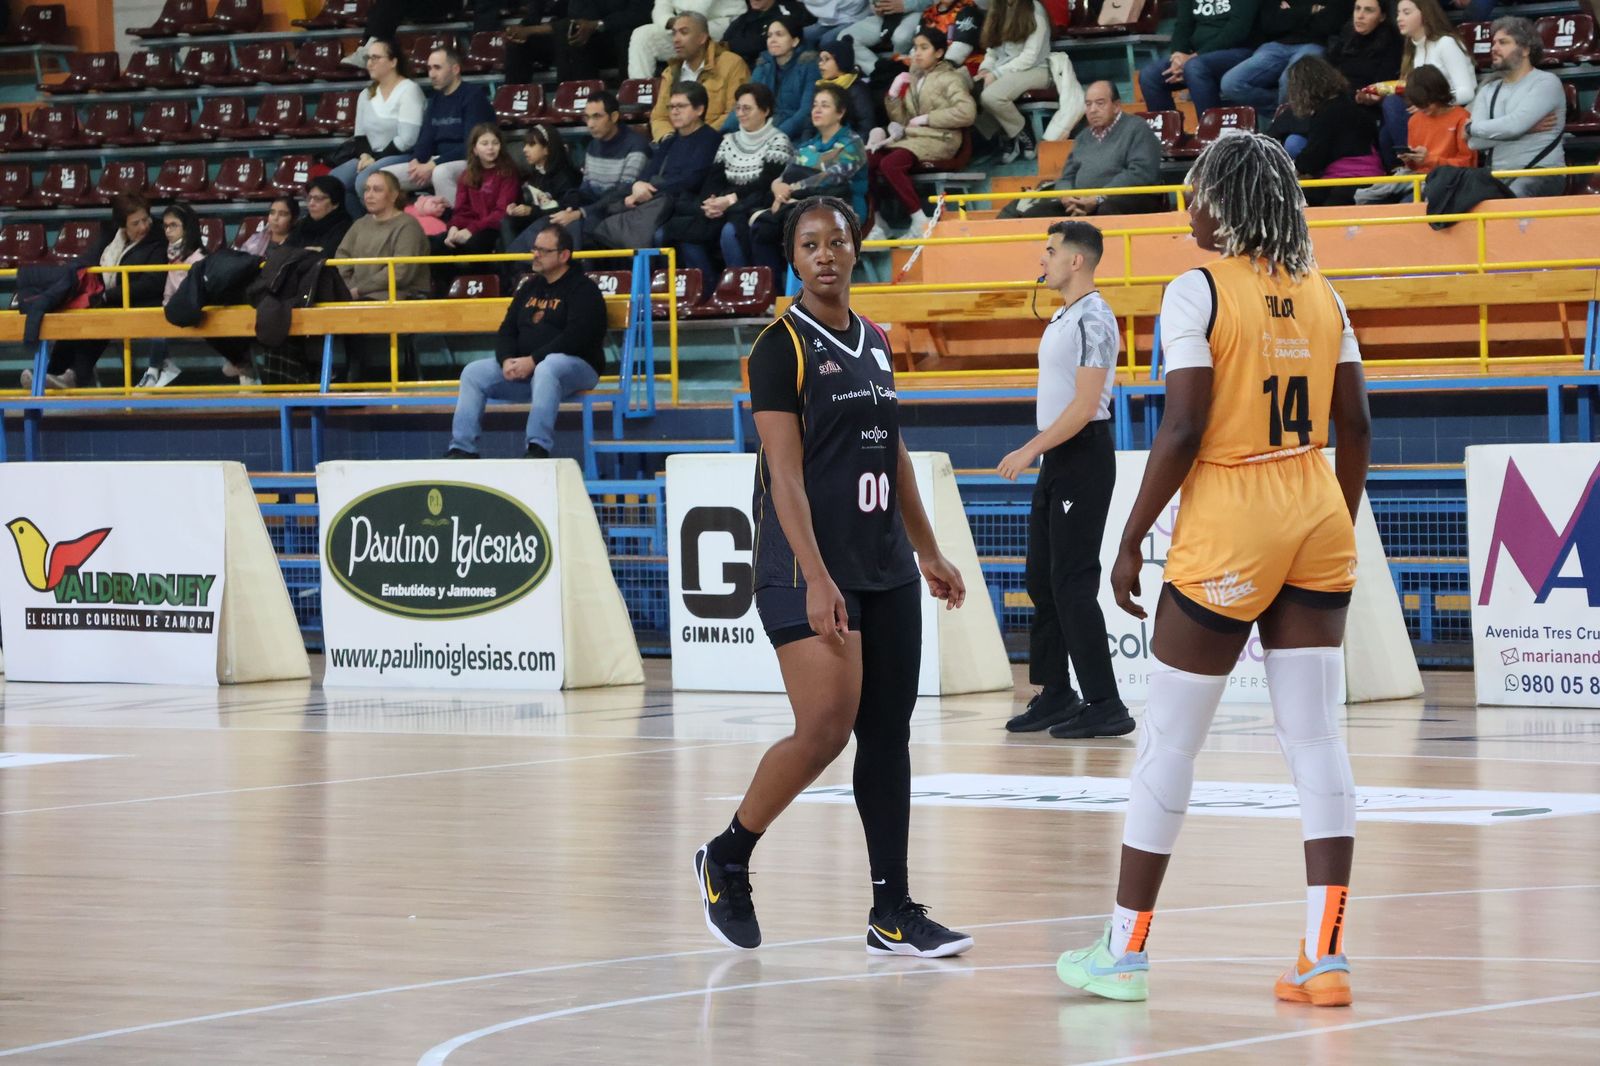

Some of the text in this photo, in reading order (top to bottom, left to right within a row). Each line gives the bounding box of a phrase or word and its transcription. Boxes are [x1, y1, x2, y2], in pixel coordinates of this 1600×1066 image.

[1556, 18, 1576, 35] 16
[1221, 113, 1238, 126] 22
[598, 275, 618, 291] 30
[832, 389, 871, 402] Fundación
[1262, 375, 1313, 447] 14
[858, 471, 890, 513] 00
[349, 515, 538, 578] Paulino Iglesias
[680, 506, 753, 619] G
[52, 570, 217, 606] VALDERADUEY
[381, 583, 497, 600] Embutidos y Jamones
[27, 612, 211, 629] EL CENTRO COMERCIAL DE ZAMORA
[682, 625, 755, 645] GIMNASIO
[1485, 625, 1539, 639] Avenida
[1543, 626, 1572, 640] Tres
[330, 642, 556, 676] www.paulinoiglesias.com
[1521, 674, 1555, 694] 980
[1560, 675, 1584, 695] 05
